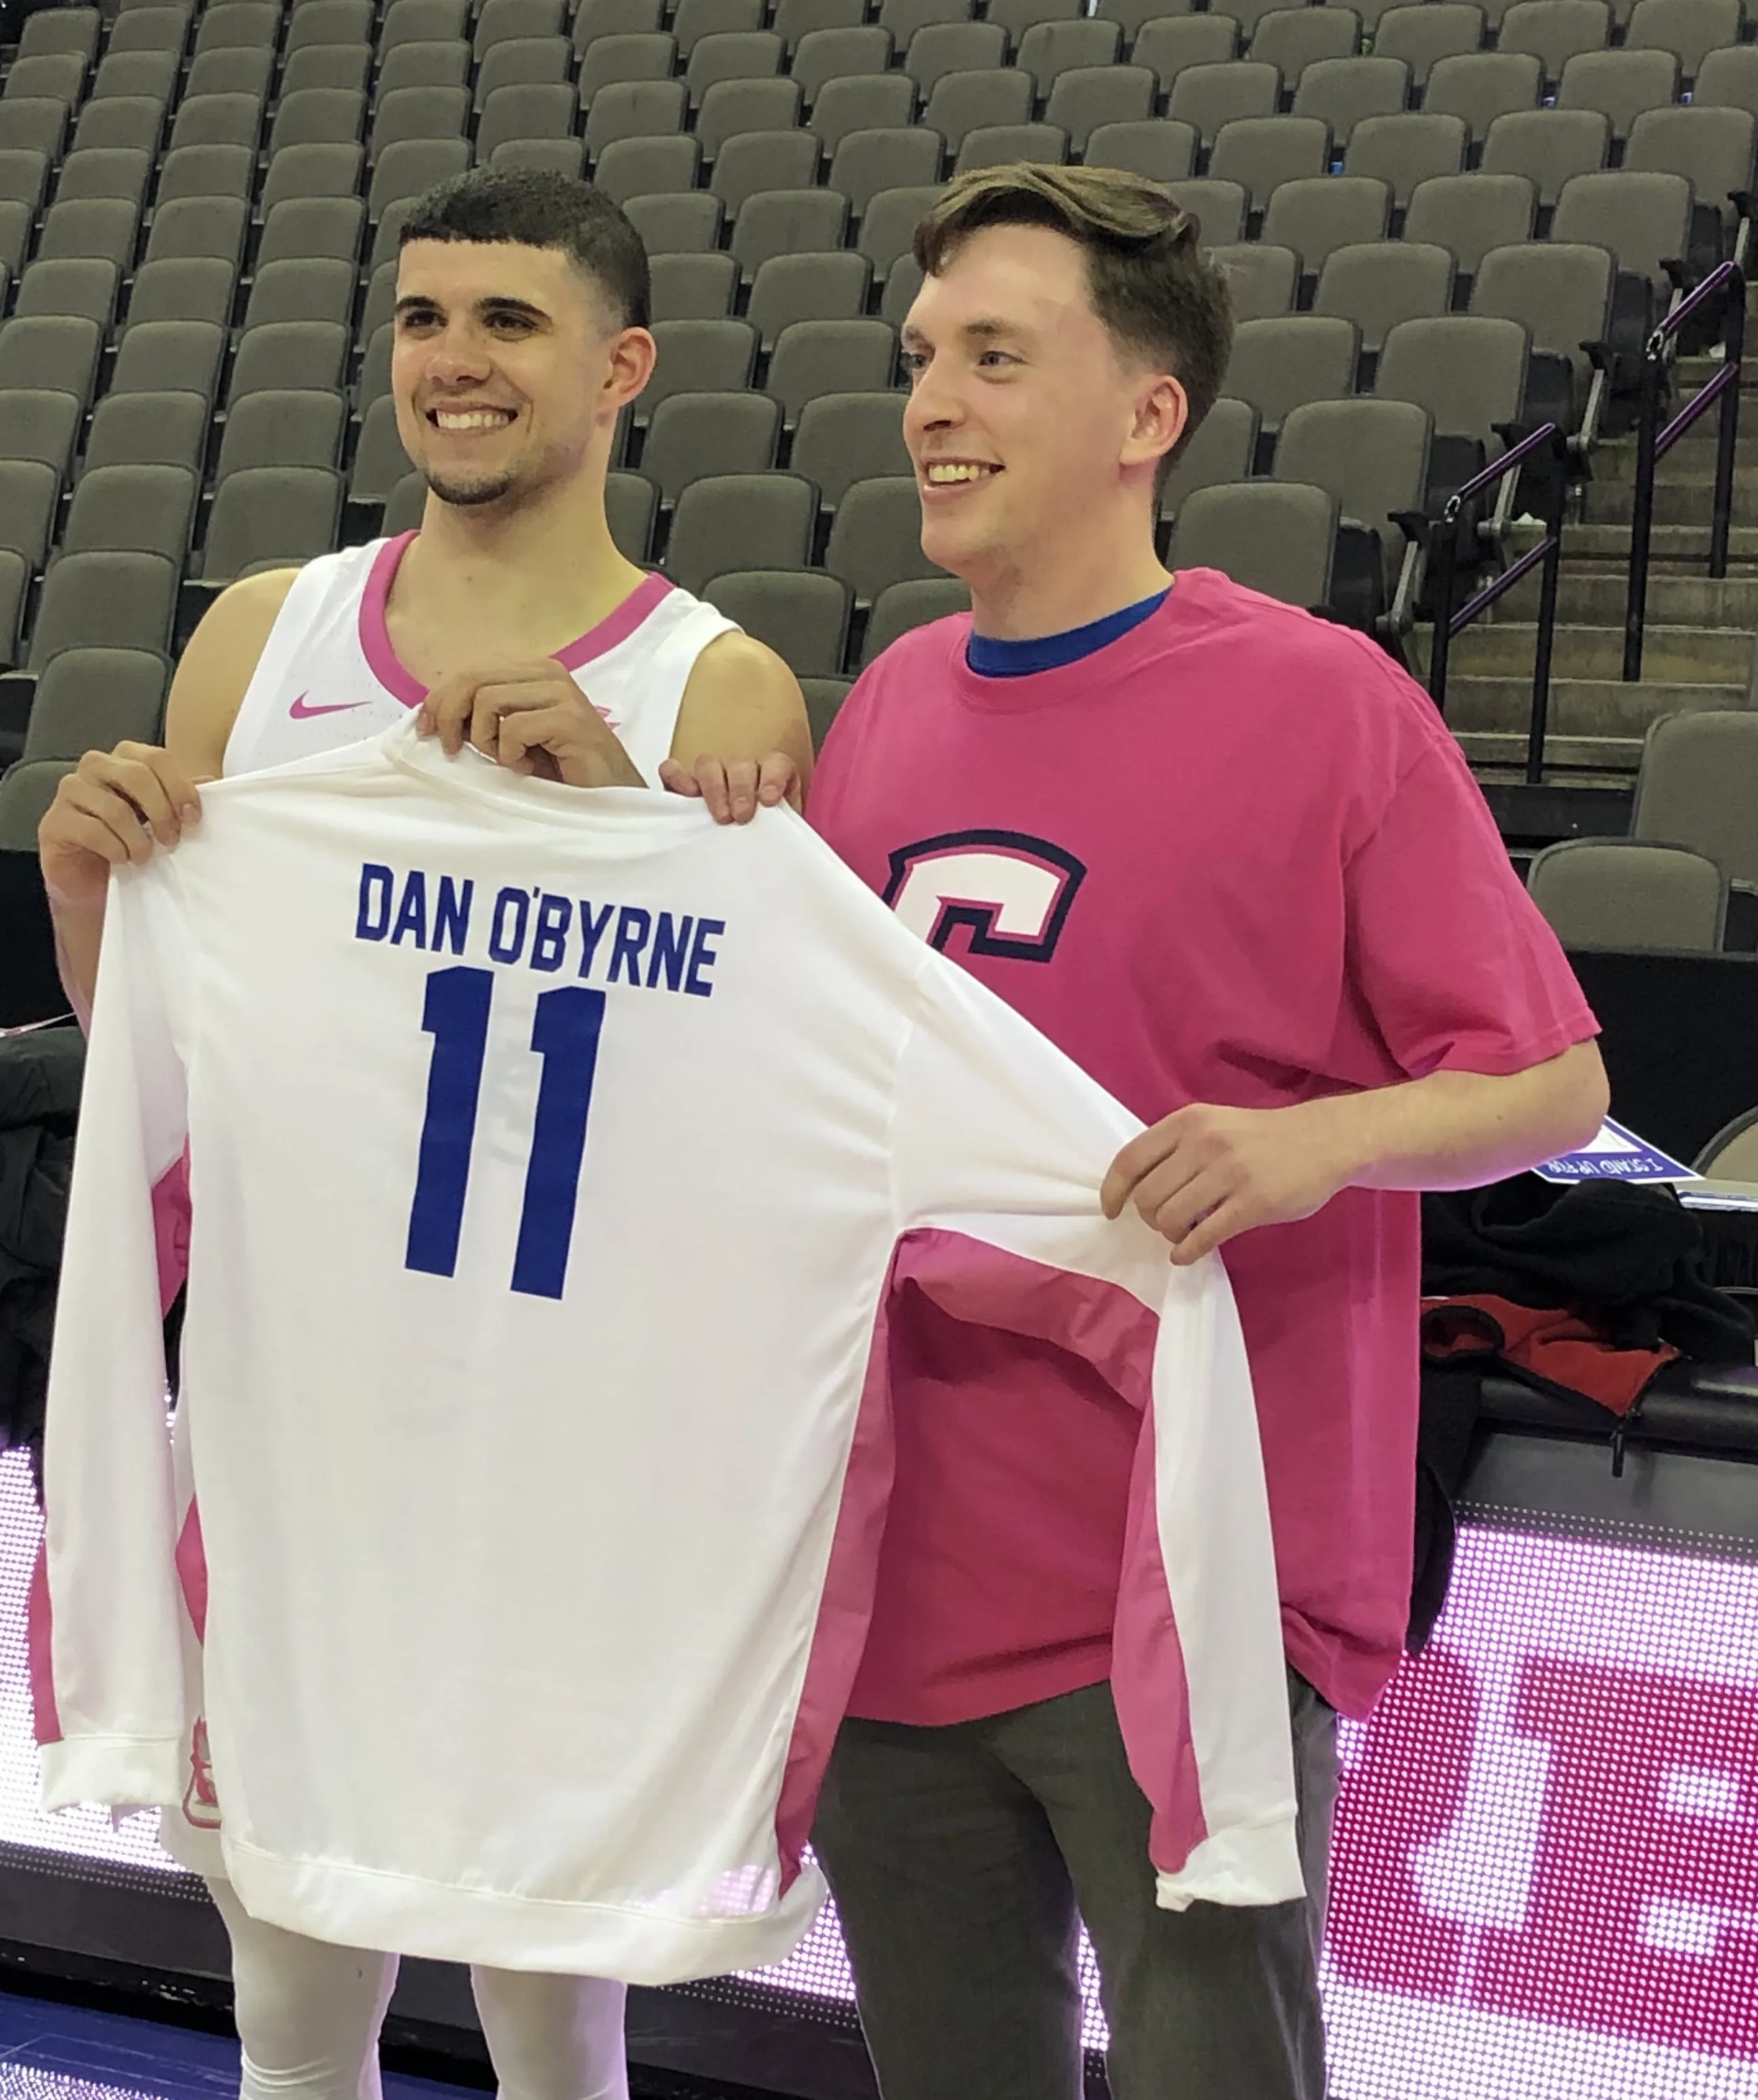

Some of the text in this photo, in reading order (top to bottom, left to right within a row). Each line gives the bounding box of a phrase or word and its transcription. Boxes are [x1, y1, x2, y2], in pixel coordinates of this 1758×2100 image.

[355, 862, 726, 998] DAN O'BYRNE
[404, 965, 607, 1300] 11
[1577, 1160, 1600, 1175] UP
[1600, 1158, 1650, 1175] STAND
